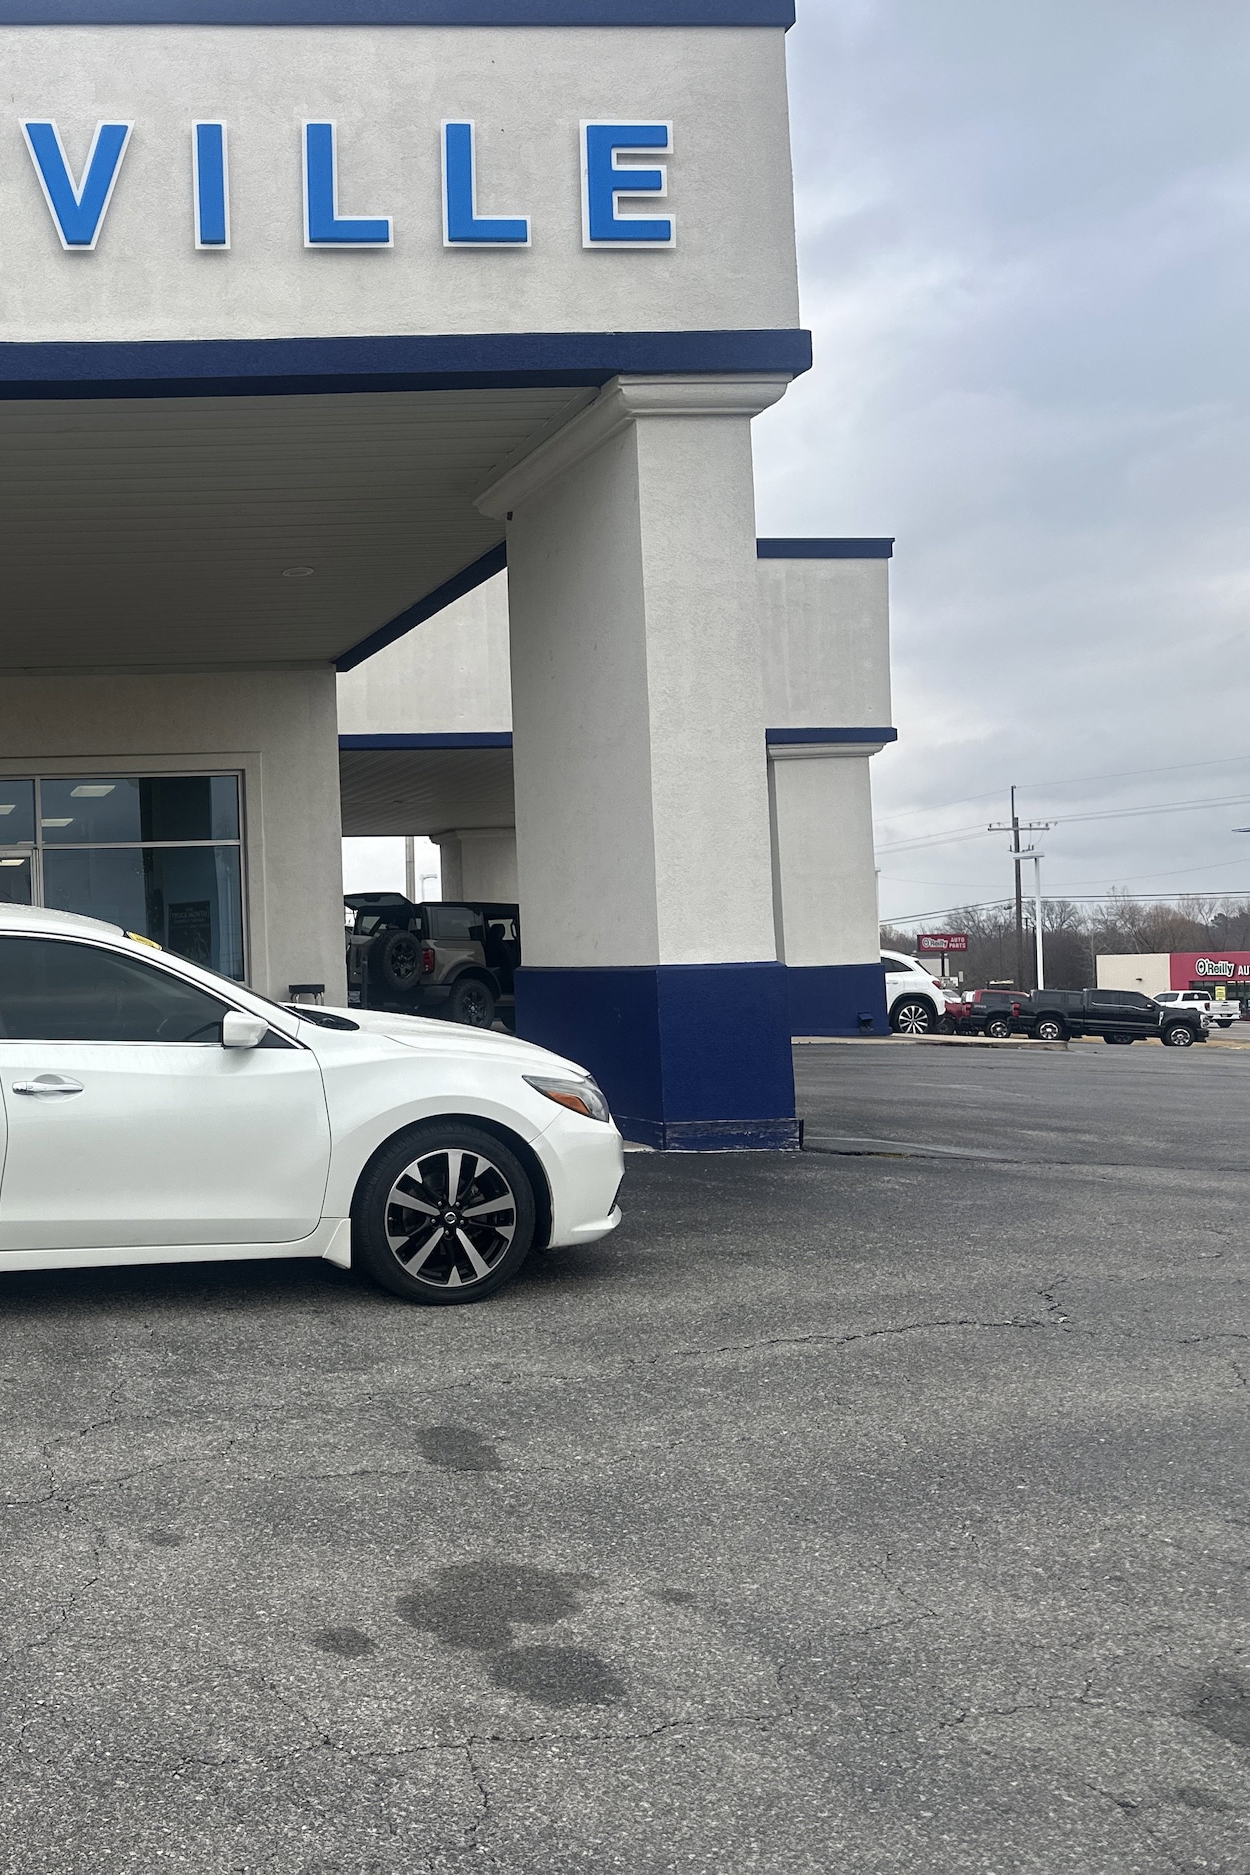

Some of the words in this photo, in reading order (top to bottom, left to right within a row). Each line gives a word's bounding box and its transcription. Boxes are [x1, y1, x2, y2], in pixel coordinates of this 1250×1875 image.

[922, 937, 948, 948] O'Reilly
[1196, 958, 1235, 977] O'Reilly
[1238, 965, 1250, 976] AU
